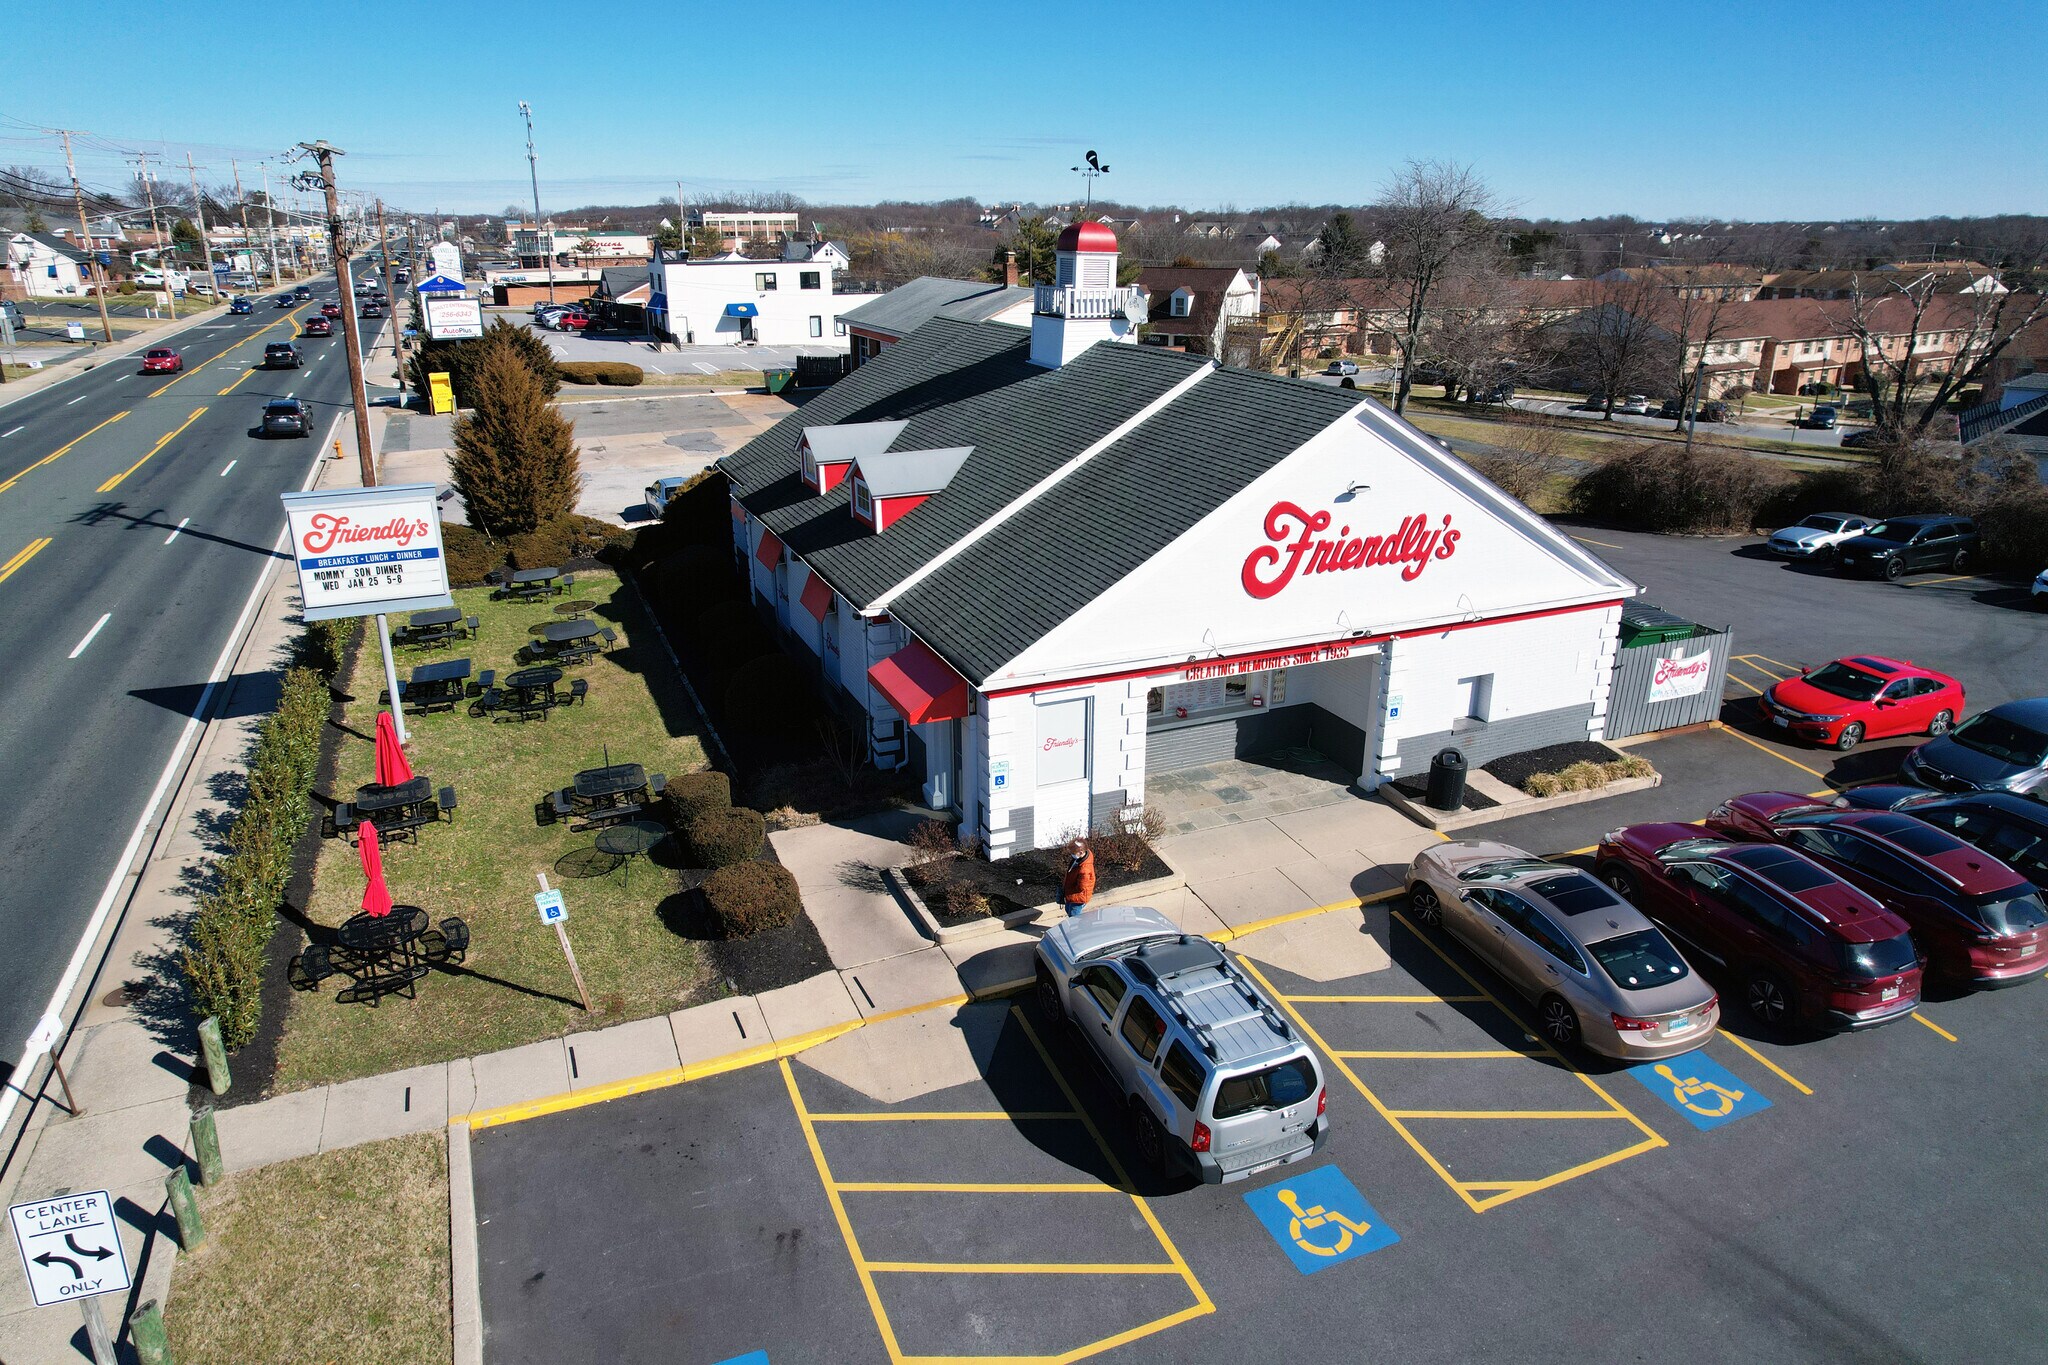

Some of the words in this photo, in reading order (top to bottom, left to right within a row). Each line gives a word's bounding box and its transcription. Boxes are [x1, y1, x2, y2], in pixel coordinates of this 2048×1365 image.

[441, 310, 472, 318] 256-6343
[303, 513, 429, 554] Friendly's
[318, 556, 359, 567] BREAKFAST
[365, 554, 389, 563] LUNCH
[396, 550, 422, 560] DINNER
[1241, 500, 1462, 600] Friendly's
[314, 569, 345, 581] MOMMY
[354, 567, 371, 578] SON
[376, 564, 404, 575] DINNER
[322, 580, 340, 591] WED
[347, 578, 364, 589] JAN
[369, 577, 379, 587] 25
[387, 574, 403, 585] 5-8
[1185, 664, 1235, 682] CREATING
[1238, 655, 1291, 674] MEMORIES
[1293, 650, 1321, 665] SINCE
[1325, 647, 1349, 660] 1935
[1654, 659, 1708, 685] Friendly's
[1043, 737, 1078, 751] Friendly's
[536, 892, 559, 902] RESERVED
[540, 898, 560, 906] PARKING
[25, 1198, 98, 1219] CENTER
[39, 1212, 91, 1231] LANE
[60, 1278, 103, 1295] ONLY
